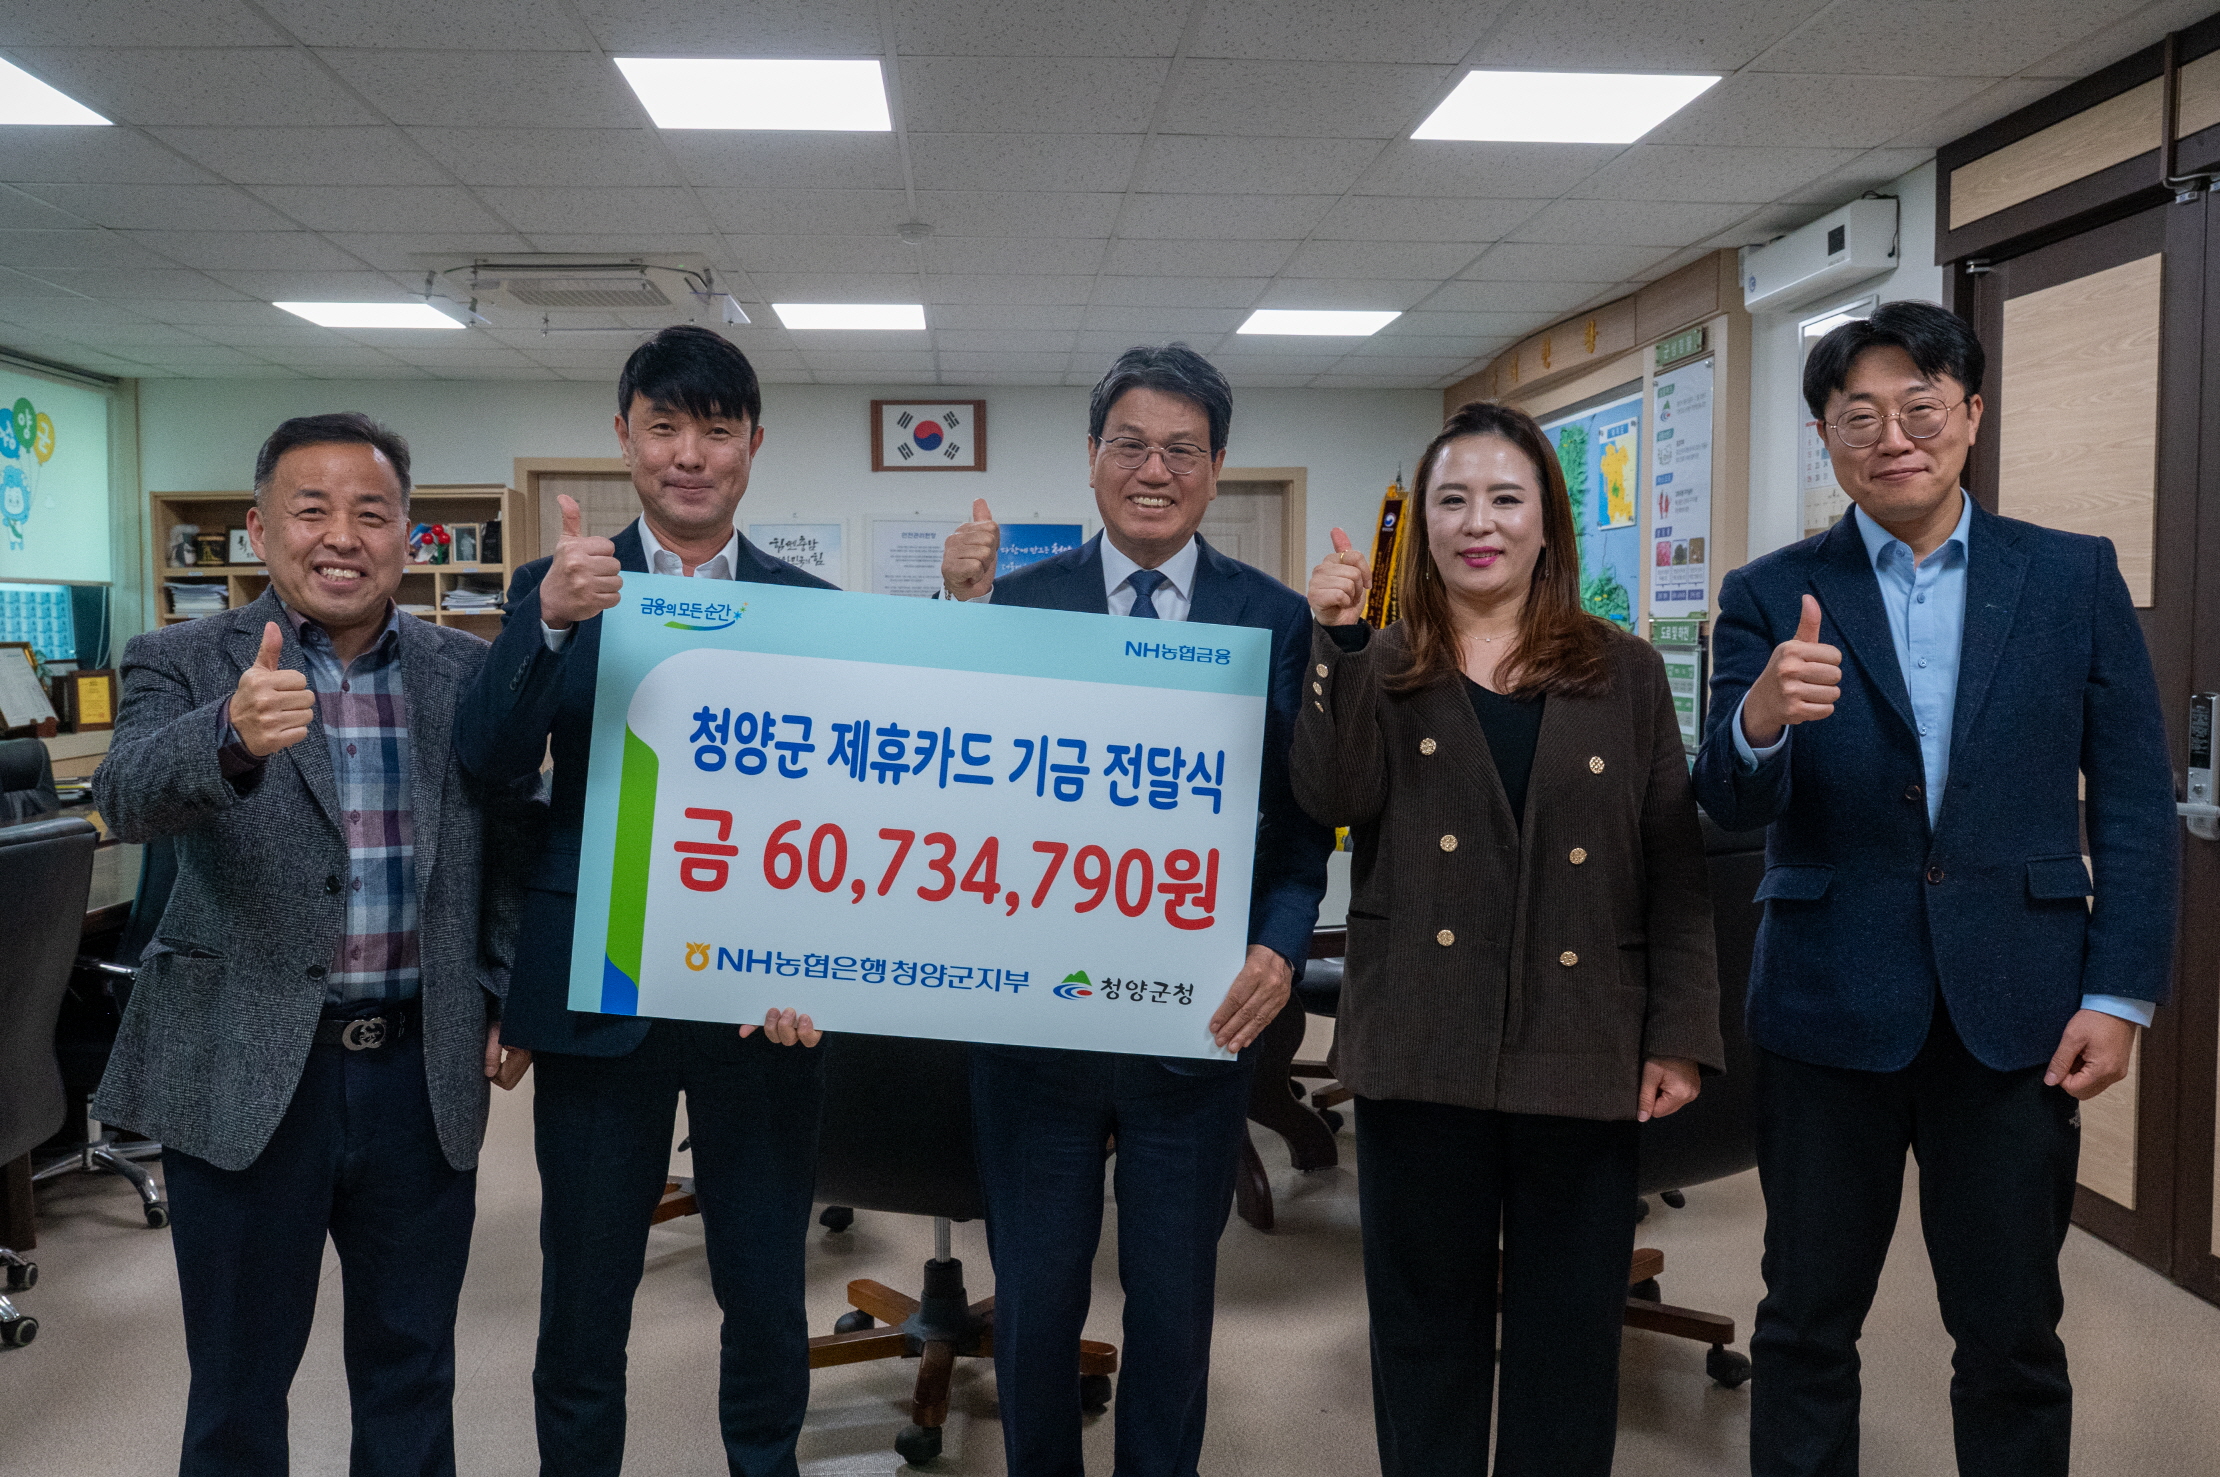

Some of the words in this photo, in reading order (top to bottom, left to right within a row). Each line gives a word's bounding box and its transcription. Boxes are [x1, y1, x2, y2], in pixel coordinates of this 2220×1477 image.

[641, 597, 677, 617] 금융의
[677, 602, 703, 620] 모든
[704, 603, 732, 622] 순간
[1125, 640, 1231, 666] NH농협금융
[690, 705, 816, 780] 청양군
[827, 720, 994, 789] 제휴카드
[1008, 735, 1091, 803] 기금
[1103, 743, 1225, 815] 전달식
[673, 807, 739, 893] 금
[762, 818, 1221, 931] 60,734,790원
[1100, 977, 1194, 1006] 청양군청
